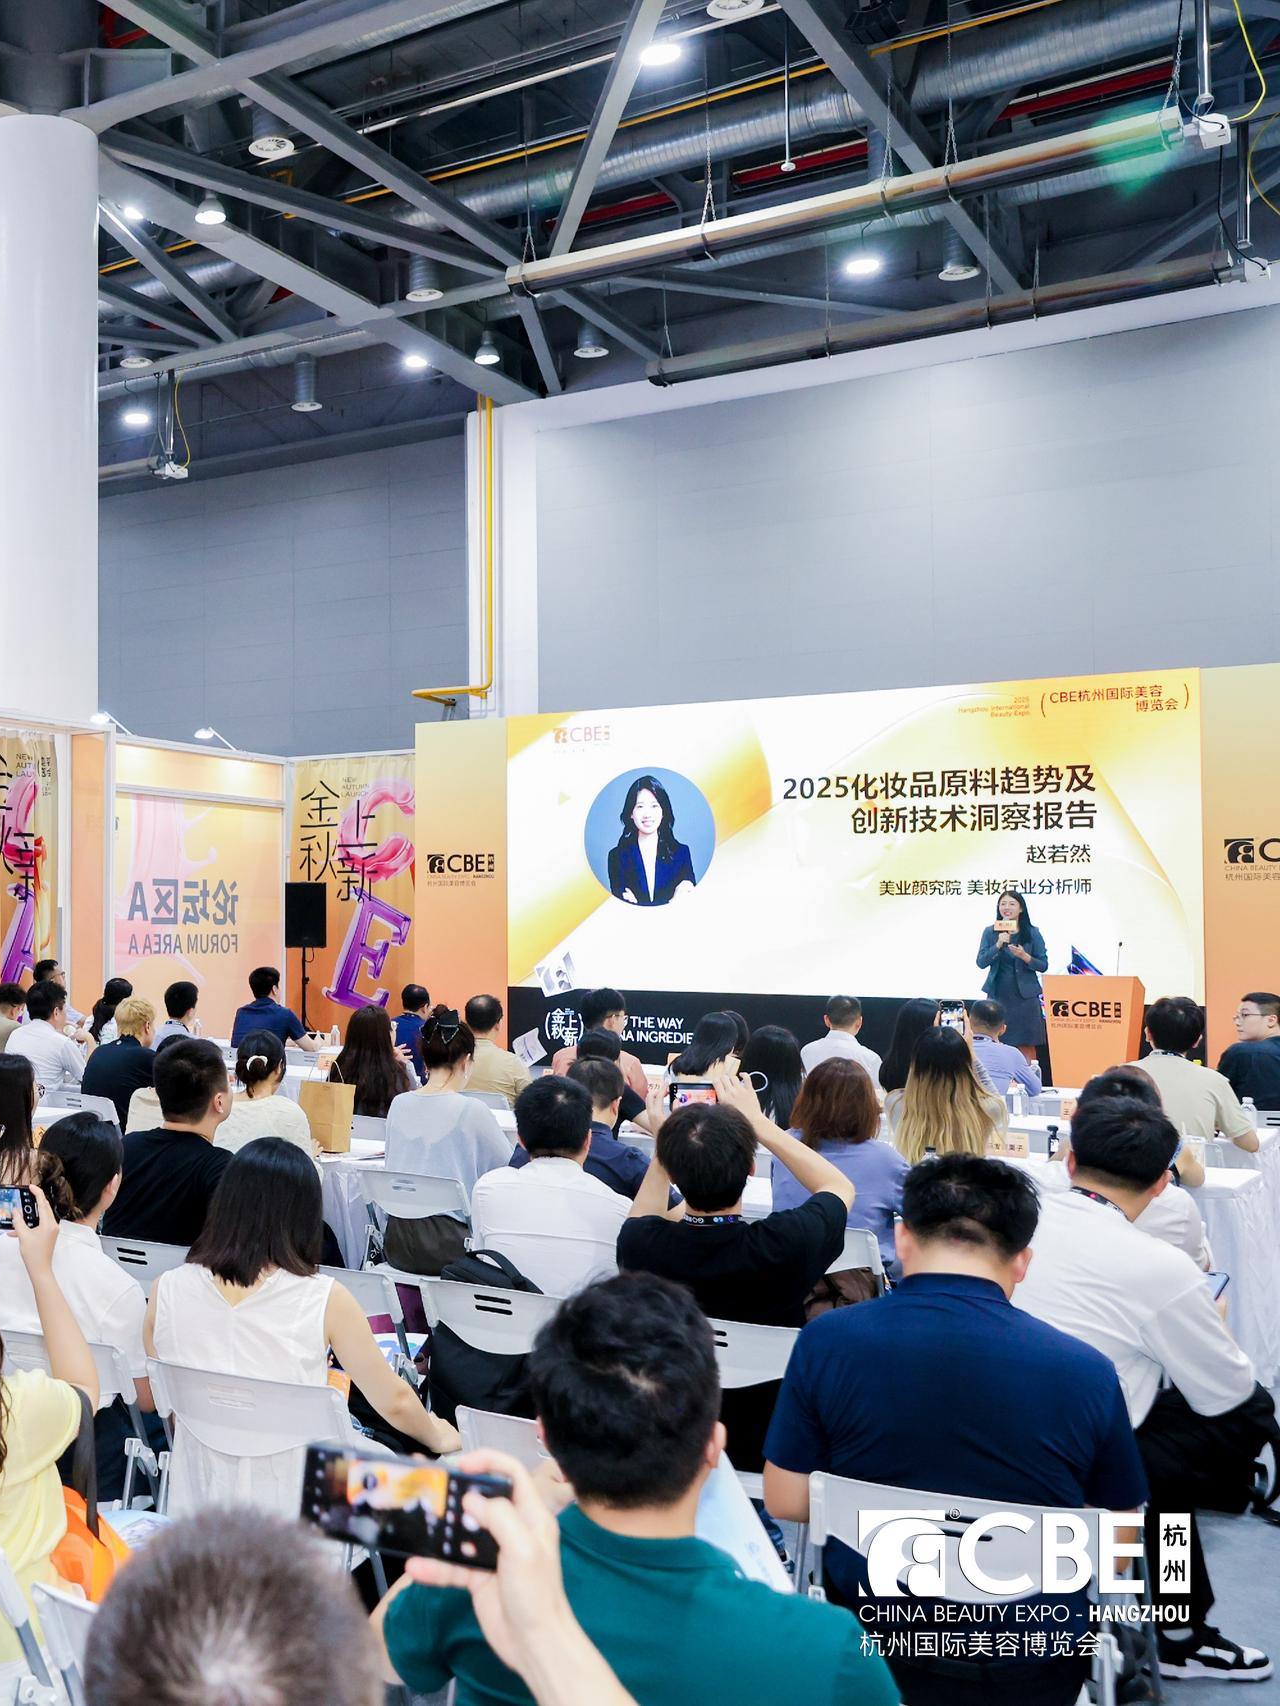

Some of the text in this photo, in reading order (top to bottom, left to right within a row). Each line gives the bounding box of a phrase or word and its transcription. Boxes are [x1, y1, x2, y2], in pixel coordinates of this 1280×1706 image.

[990, 703, 1030, 711] International
[990, 709, 1031, 719] Beauty Expo
[570, 726, 602, 742] CBE
[783, 764, 1096, 801] 2025化妆品原料趋势及
[851, 800, 1098, 834] 创新技术洞察报告
[1026, 844, 1091, 864] 赵若然
[447, 854, 485, 873] CBE
[879, 879, 1092, 897] 美业颜究院 美妆行业分析师
[1072, 1001, 1112, 1018] CBE
[630, 1016, 656, 1029] THE
[657, 1017, 685, 1030] WAY
